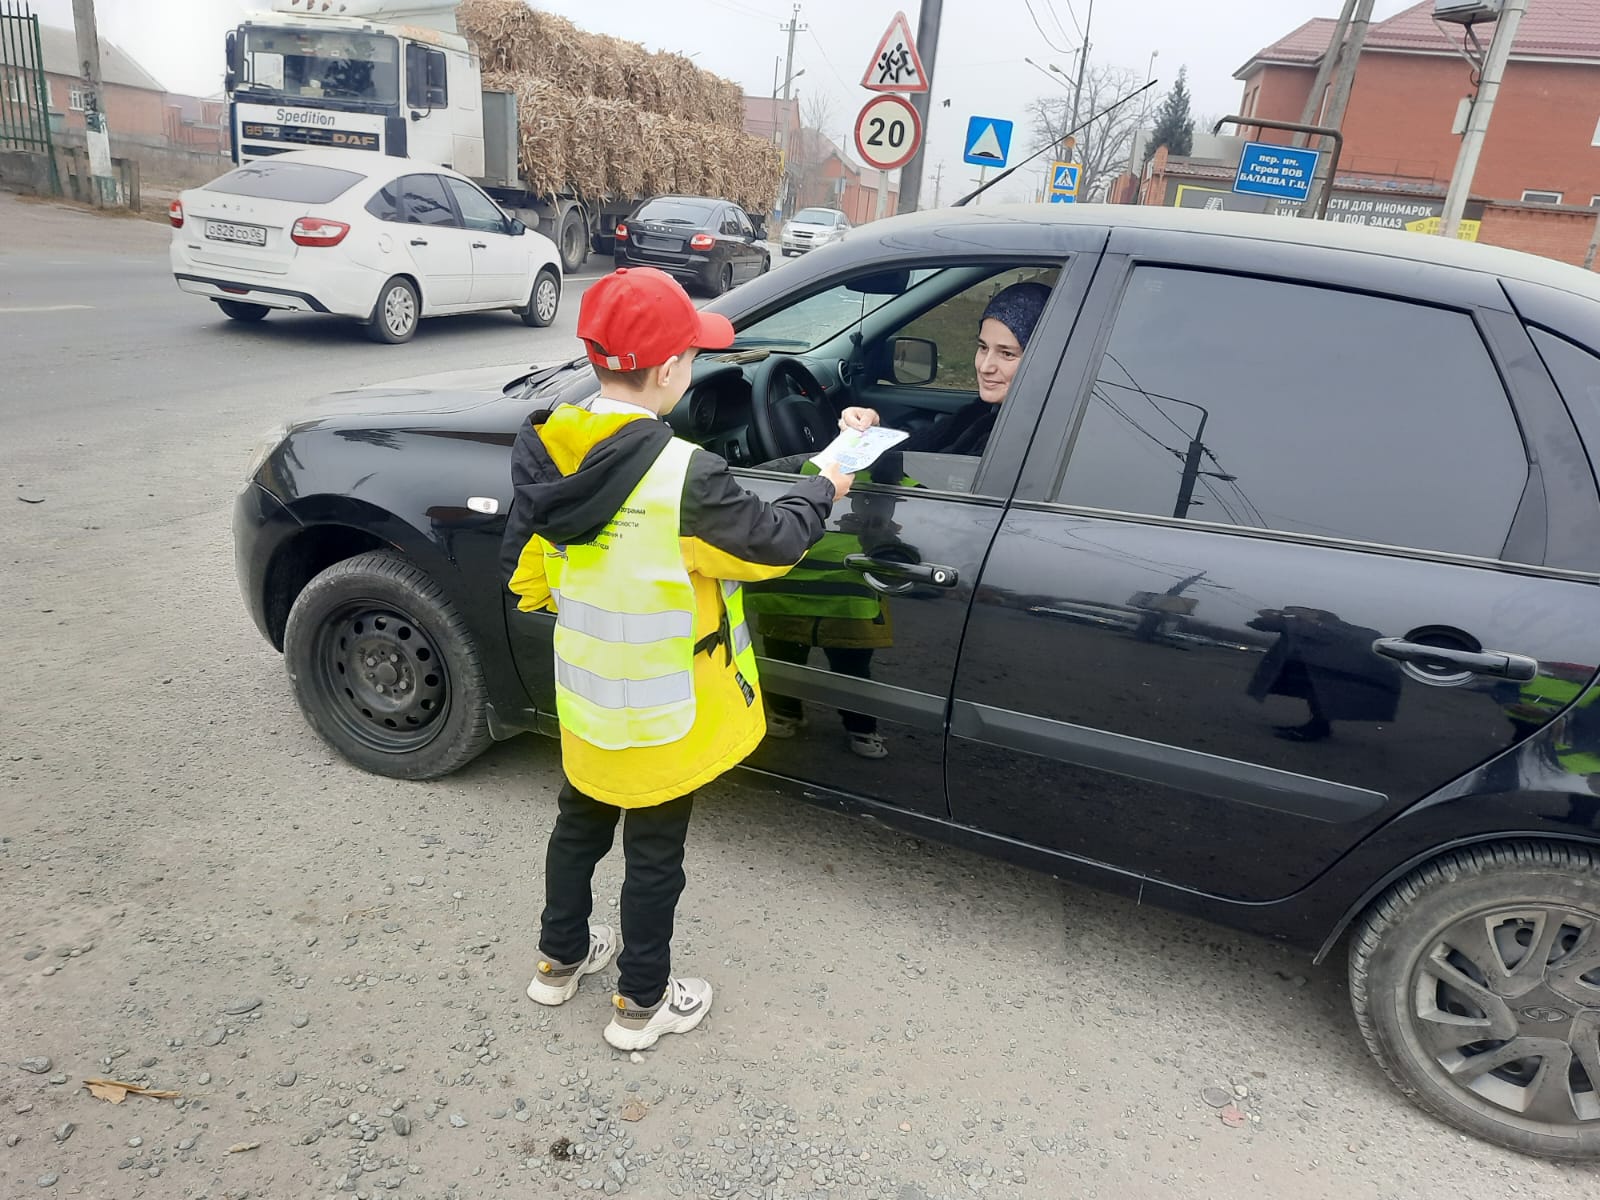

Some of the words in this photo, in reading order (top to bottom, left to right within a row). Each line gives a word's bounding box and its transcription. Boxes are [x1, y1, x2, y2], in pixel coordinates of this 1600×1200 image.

[276, 108, 335, 126] Spedition
[332, 133, 376, 145] DAF
[866, 117, 905, 148] 20
[1258, 155, 1280, 165] пер.
[1282, 158, 1299, 166] им.
[1250, 163, 1279, 174] Героя
[1281, 167, 1303, 178] ВОВ
[1239, 172, 1286, 186] БАЛАЕВА
[1288, 179, 1307, 190] Г.Ц.
[1350, 200, 1373, 212] ДЛЯ
[1375, 203, 1433, 217] ИНОМАРОК
[1369, 216, 1402, 228] ЗАКАЗ
